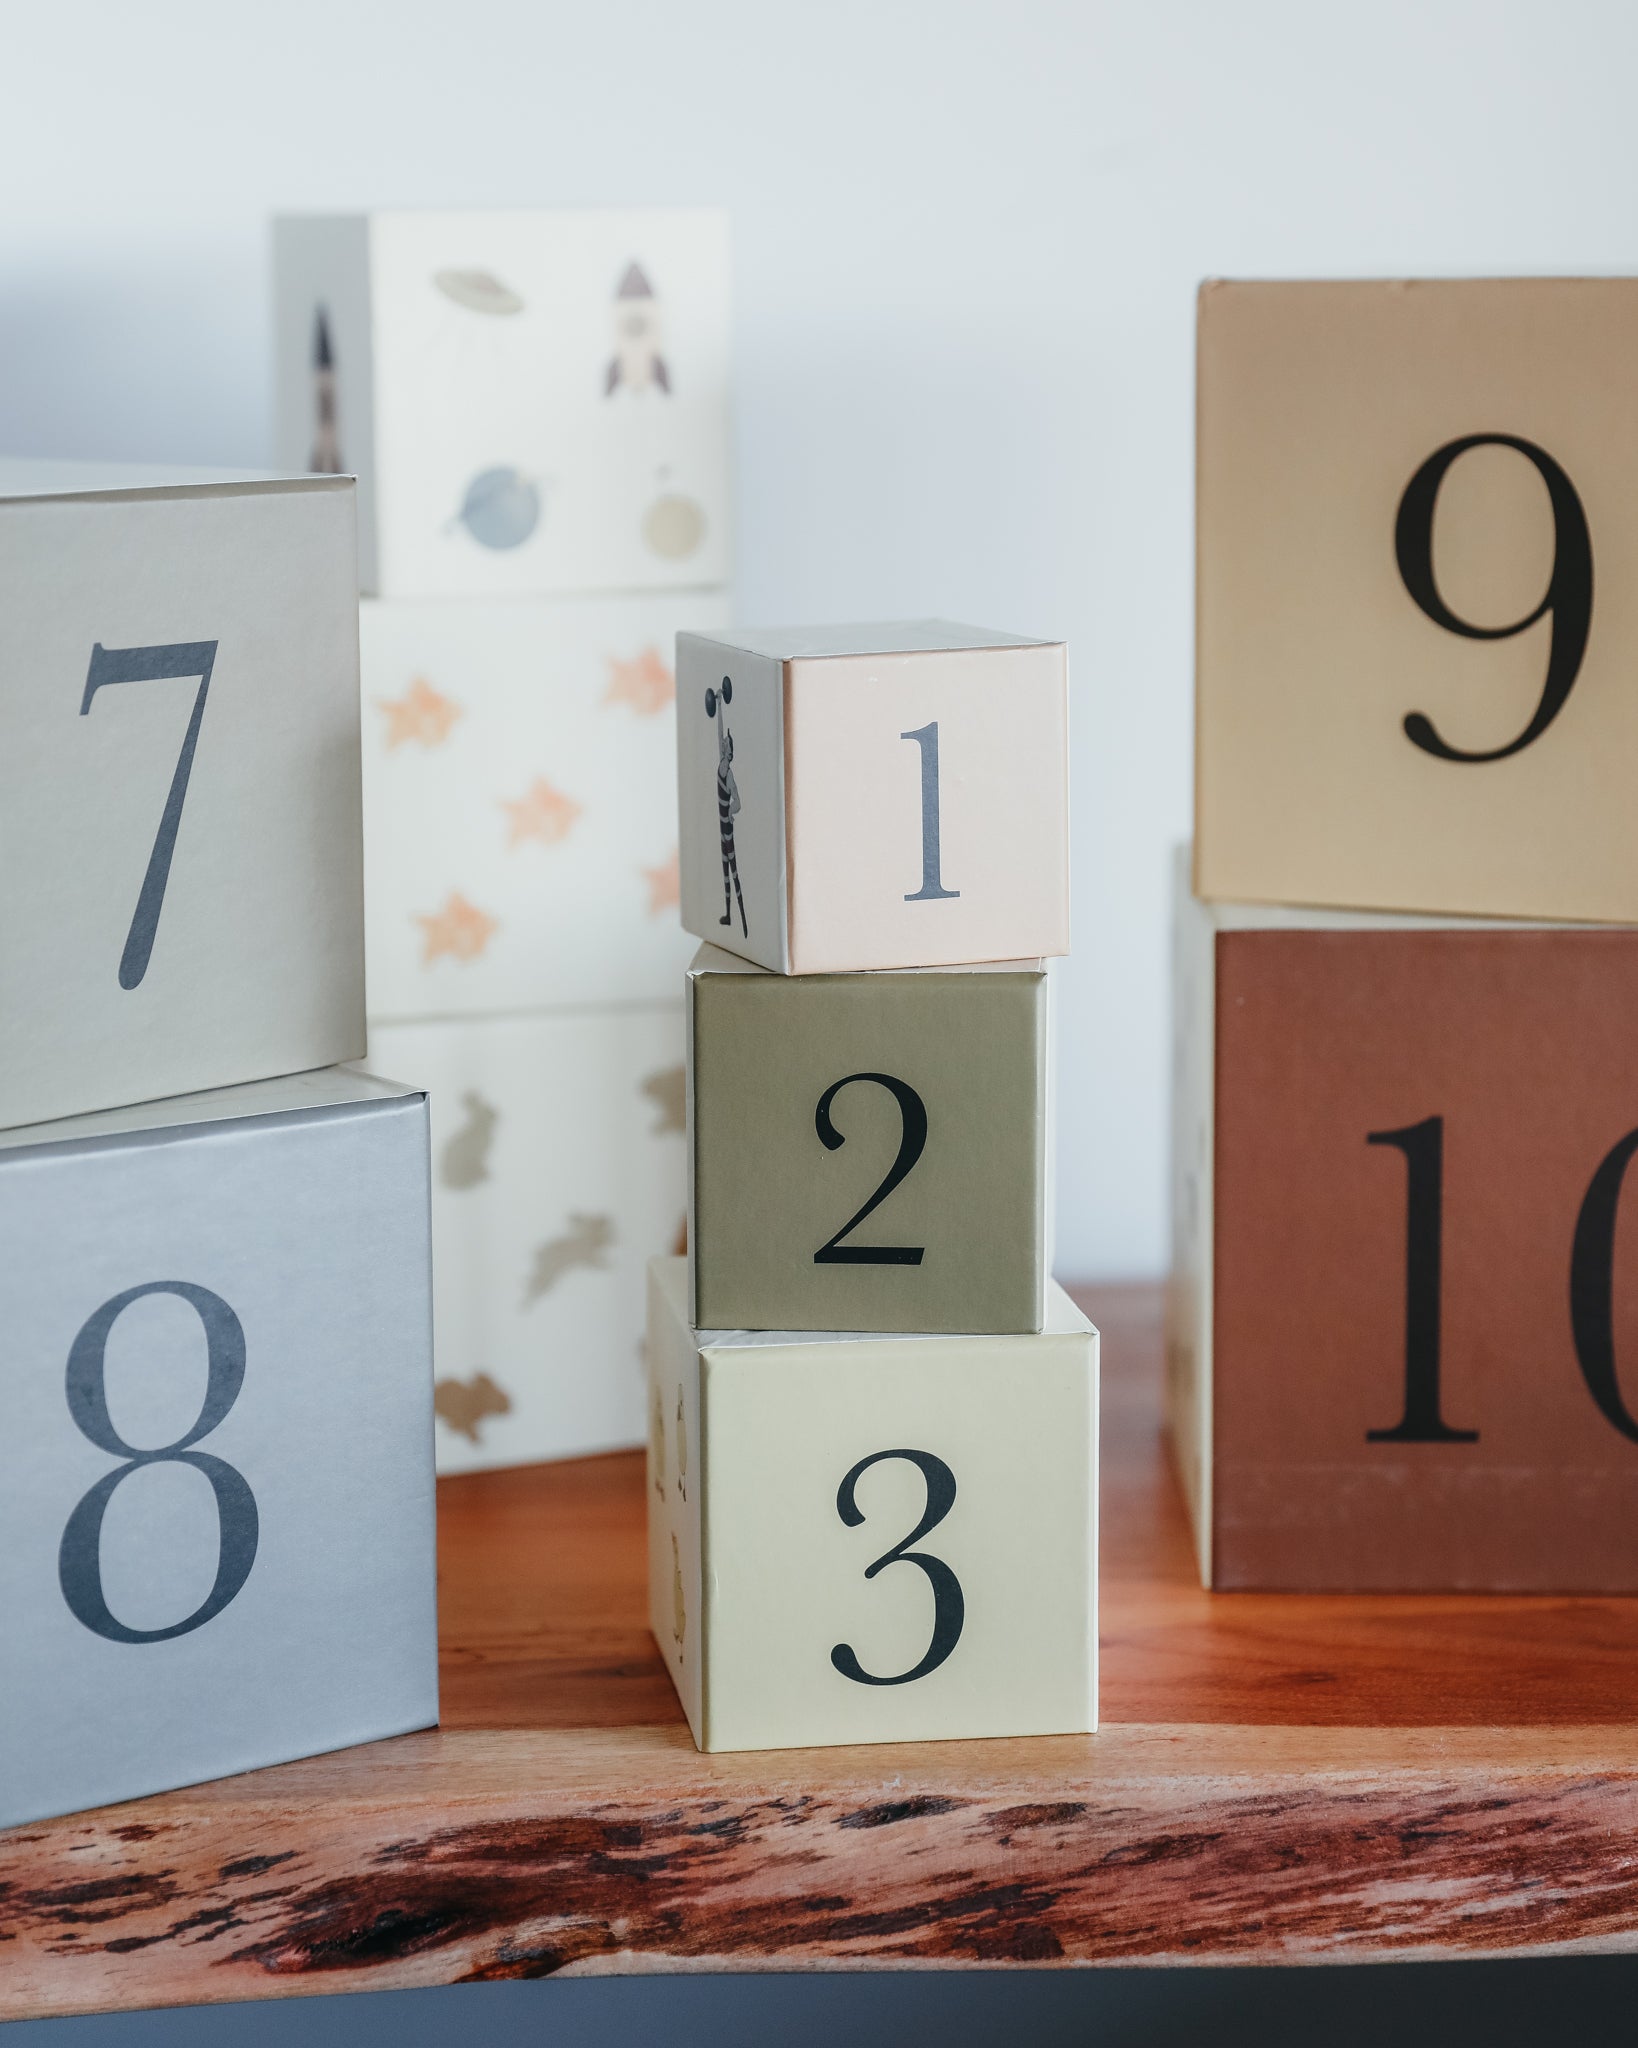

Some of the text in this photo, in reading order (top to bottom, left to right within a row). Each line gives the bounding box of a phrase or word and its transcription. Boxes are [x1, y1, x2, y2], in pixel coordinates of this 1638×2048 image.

[1393, 432, 1595, 764] 9
[79, 639, 219, 991] 7
[900, 721, 961, 902] 1
[814, 1072, 928, 1266] 2
[57, 1280, 260, 1645] 8
[830, 1448, 965, 1686] 3
